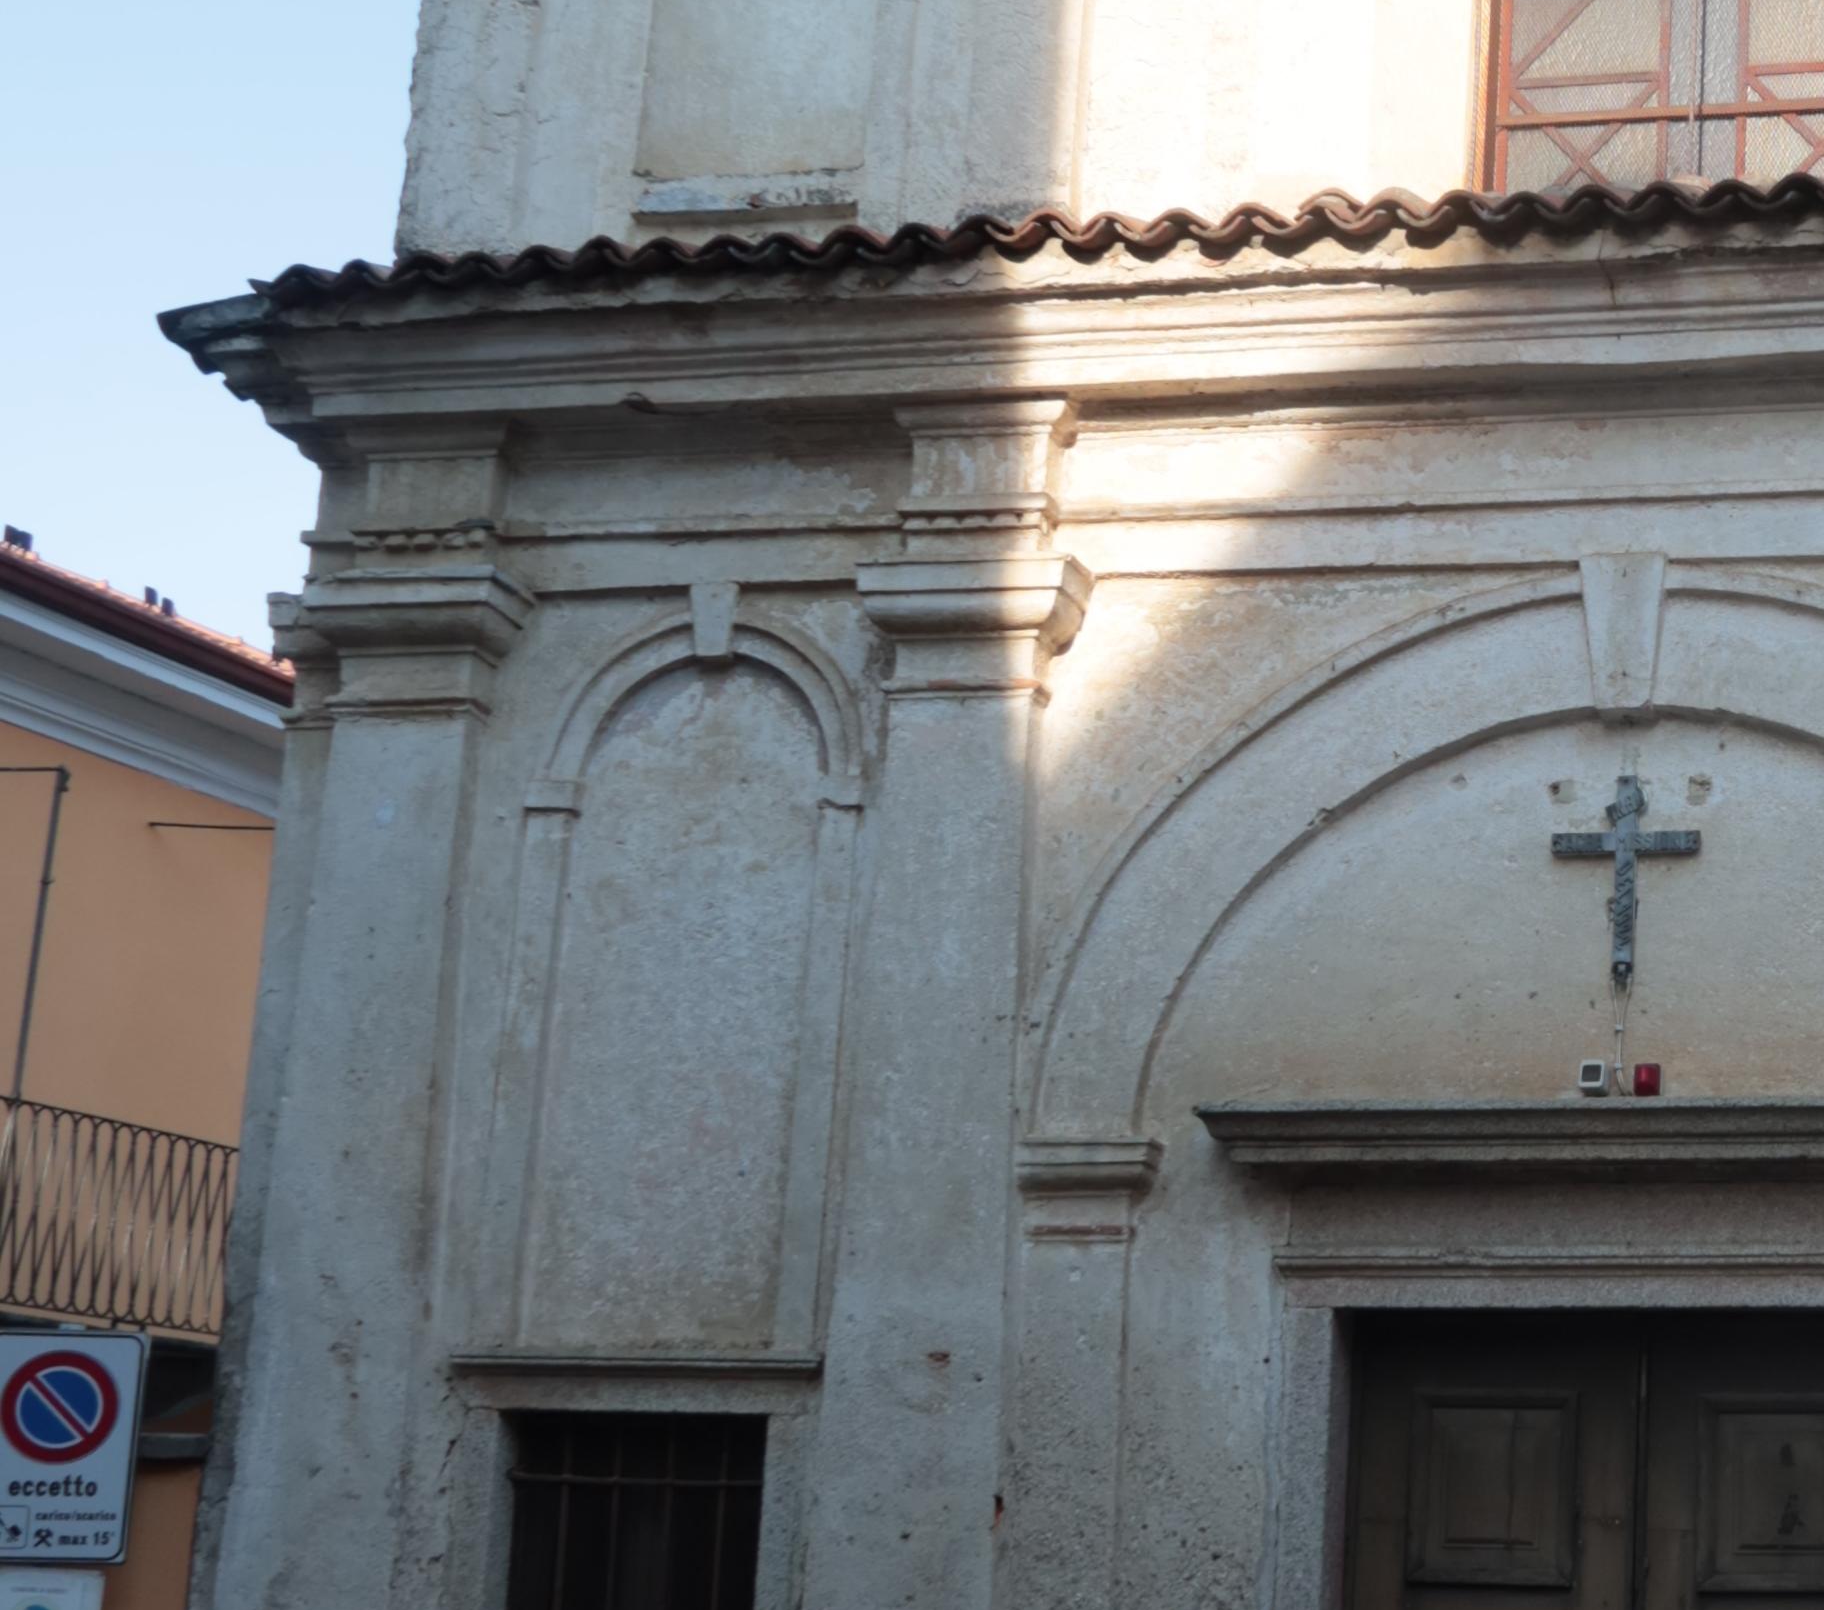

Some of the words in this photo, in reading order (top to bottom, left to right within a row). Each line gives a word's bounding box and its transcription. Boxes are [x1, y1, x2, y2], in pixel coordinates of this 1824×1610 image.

[8, 1474, 98, 1497] eccetto
[35, 1508, 117, 1521] carico/scarico
[58, 1534, 88, 1546] max
